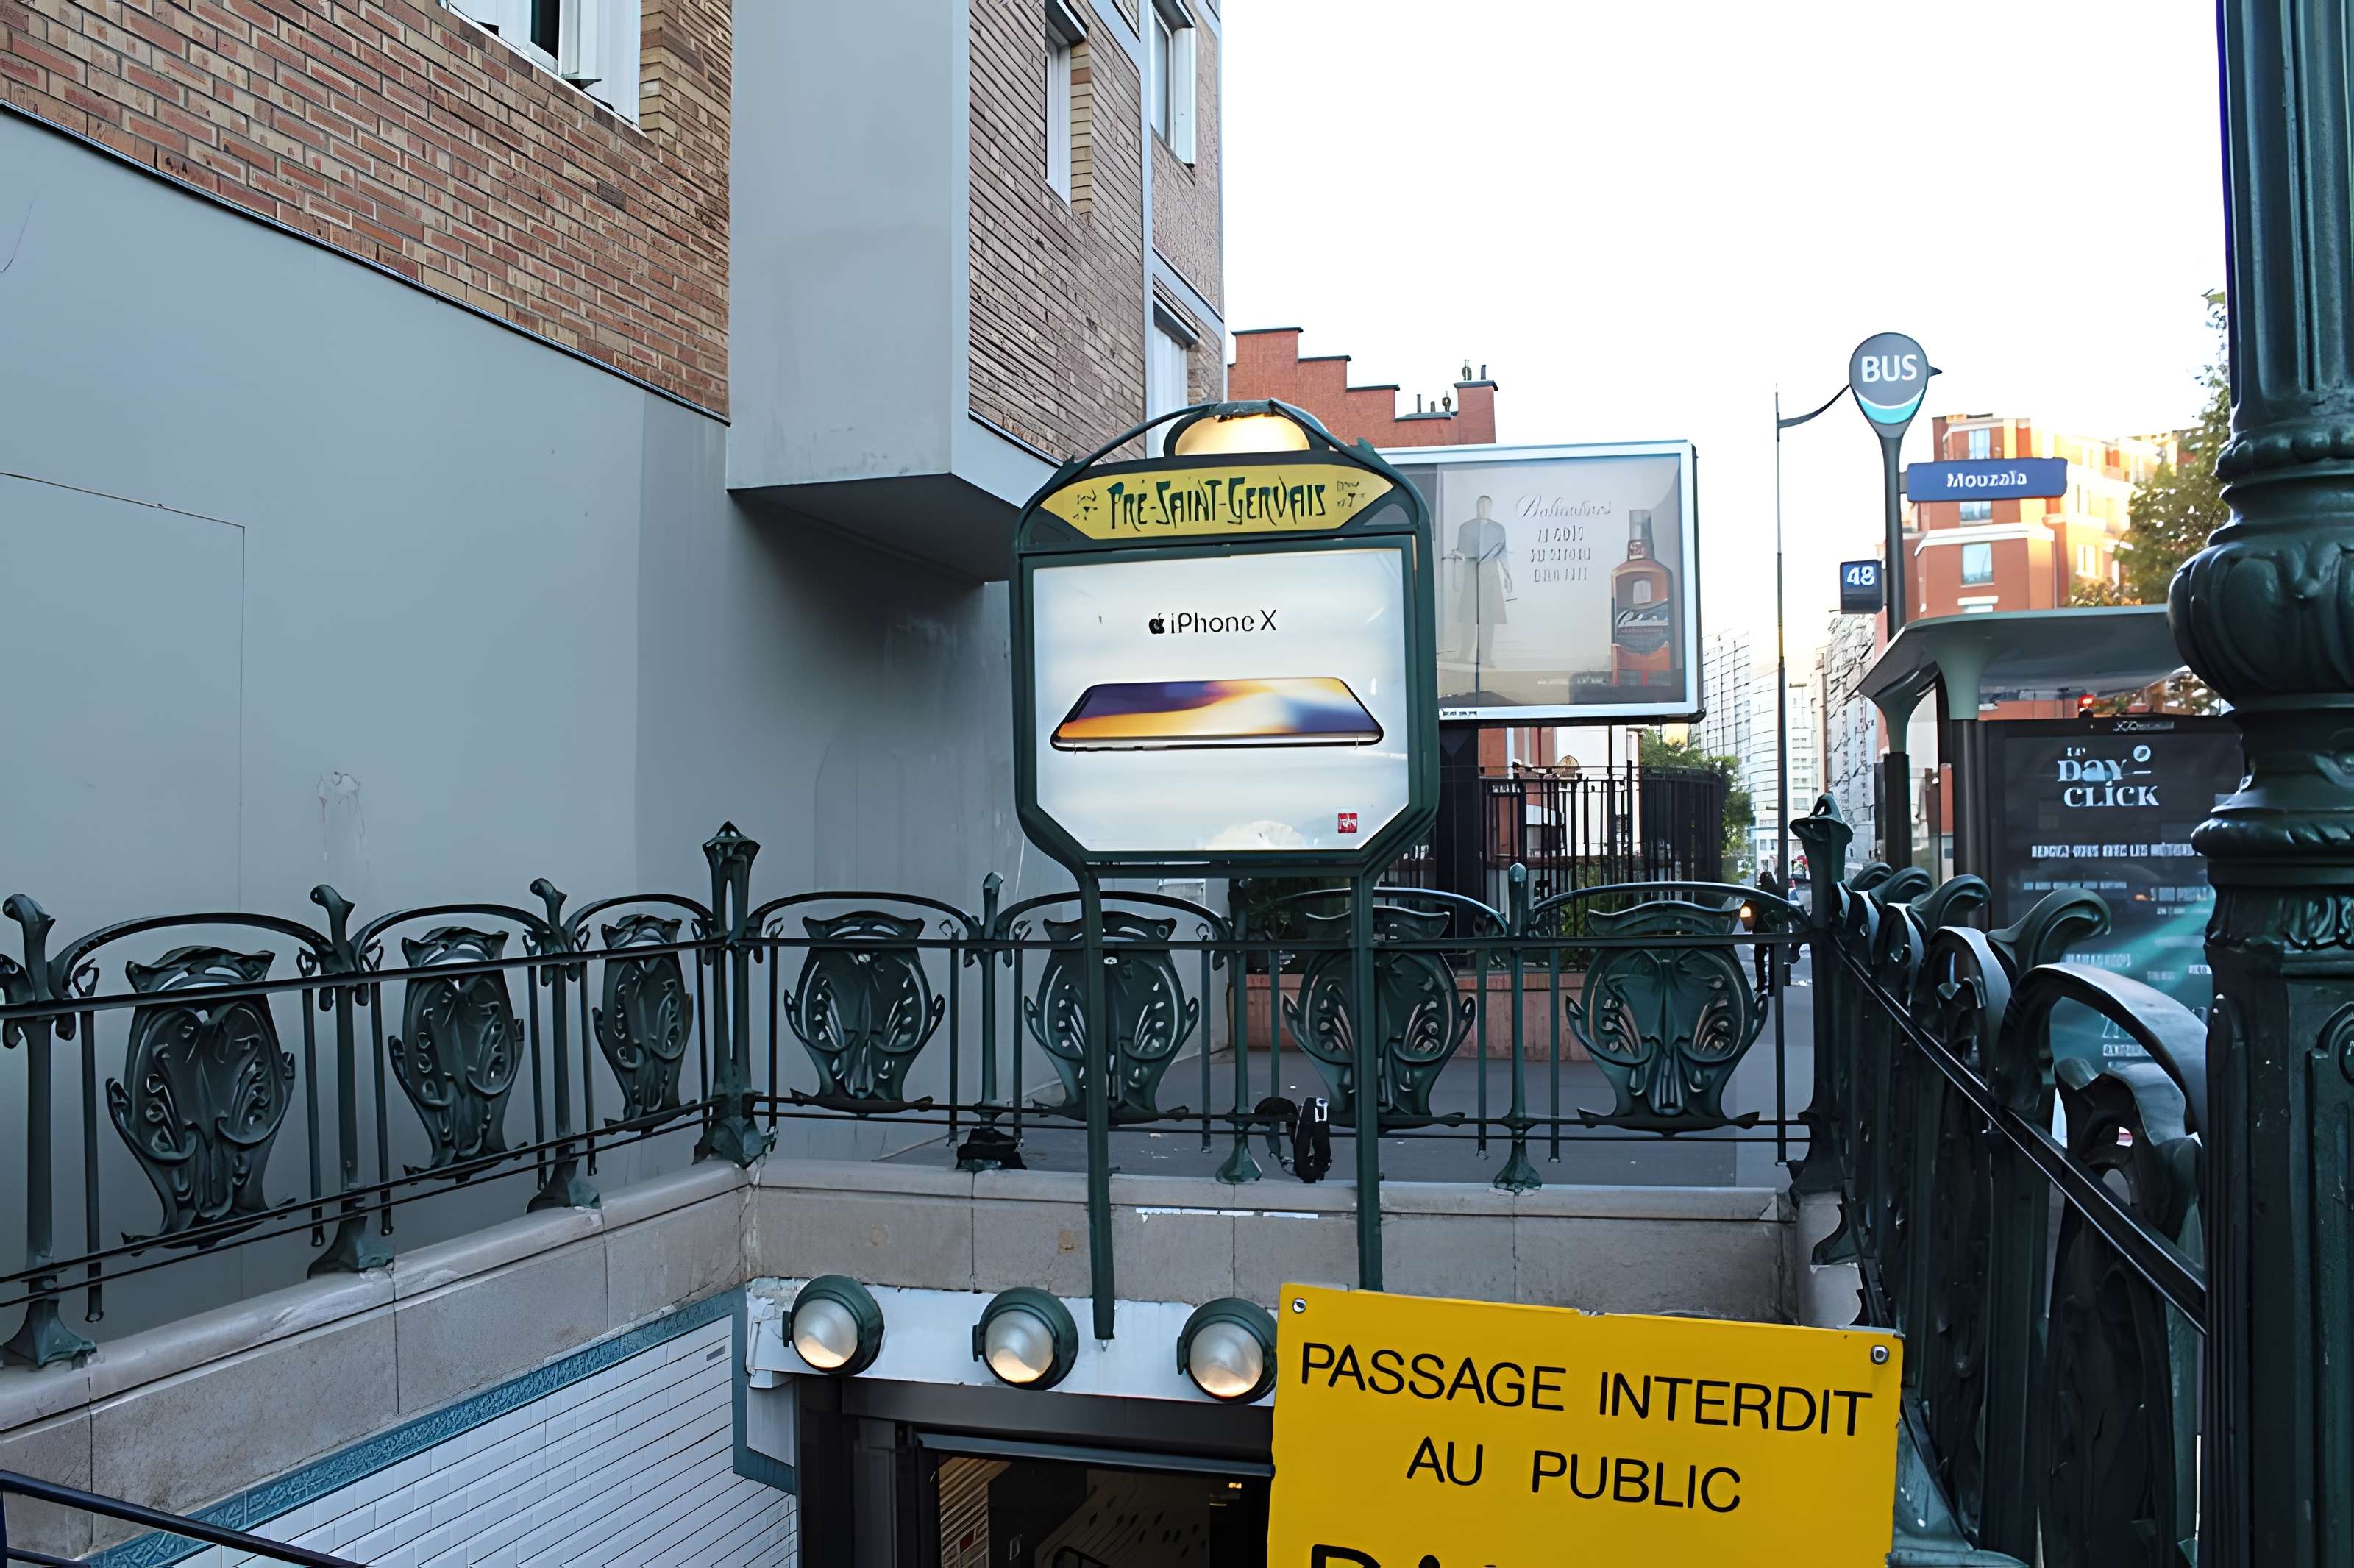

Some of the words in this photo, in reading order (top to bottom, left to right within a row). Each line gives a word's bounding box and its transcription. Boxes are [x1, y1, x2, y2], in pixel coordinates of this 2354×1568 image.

[1861, 354, 1917, 383] BUS
[1846, 566, 1875, 585] 48
[1170, 612, 1254, 634] iPhone
[1260, 609, 1277, 631] X
[1301, 1342, 1566, 1411] PASSAGE
[1599, 1372, 1873, 1436] INTERDIT
[1406, 1436, 1484, 1486] AU
[1532, 1450, 1741, 1513] PUBLIC
